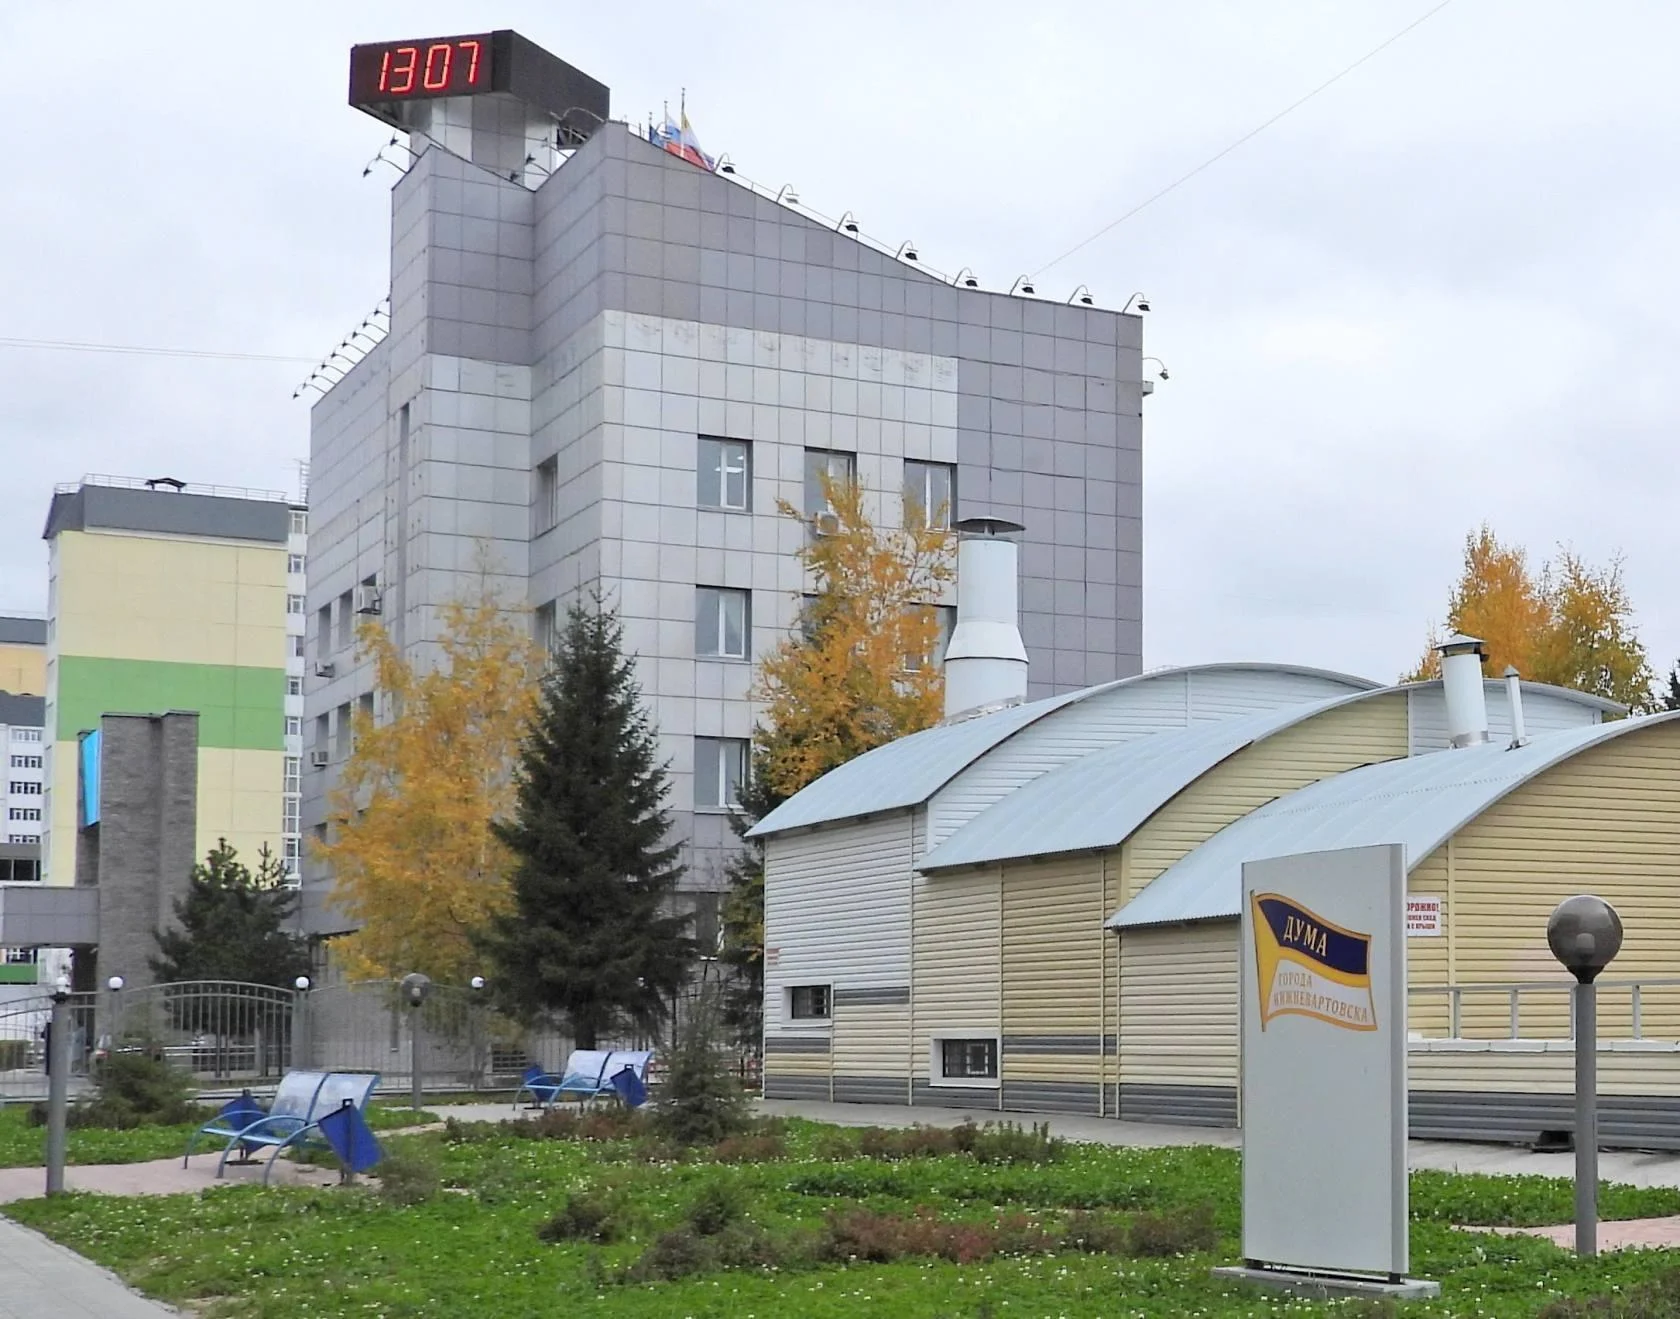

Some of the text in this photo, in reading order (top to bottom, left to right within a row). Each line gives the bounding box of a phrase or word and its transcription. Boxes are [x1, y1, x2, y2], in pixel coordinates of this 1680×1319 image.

[379, 41, 480, 92] 1307
[1284, 915, 1327, 957] ДУМА
[1278, 973, 1313, 988] ГОРОДА
[1273, 990, 1368, 1022] НИЖНЕВАРТОВСКА
